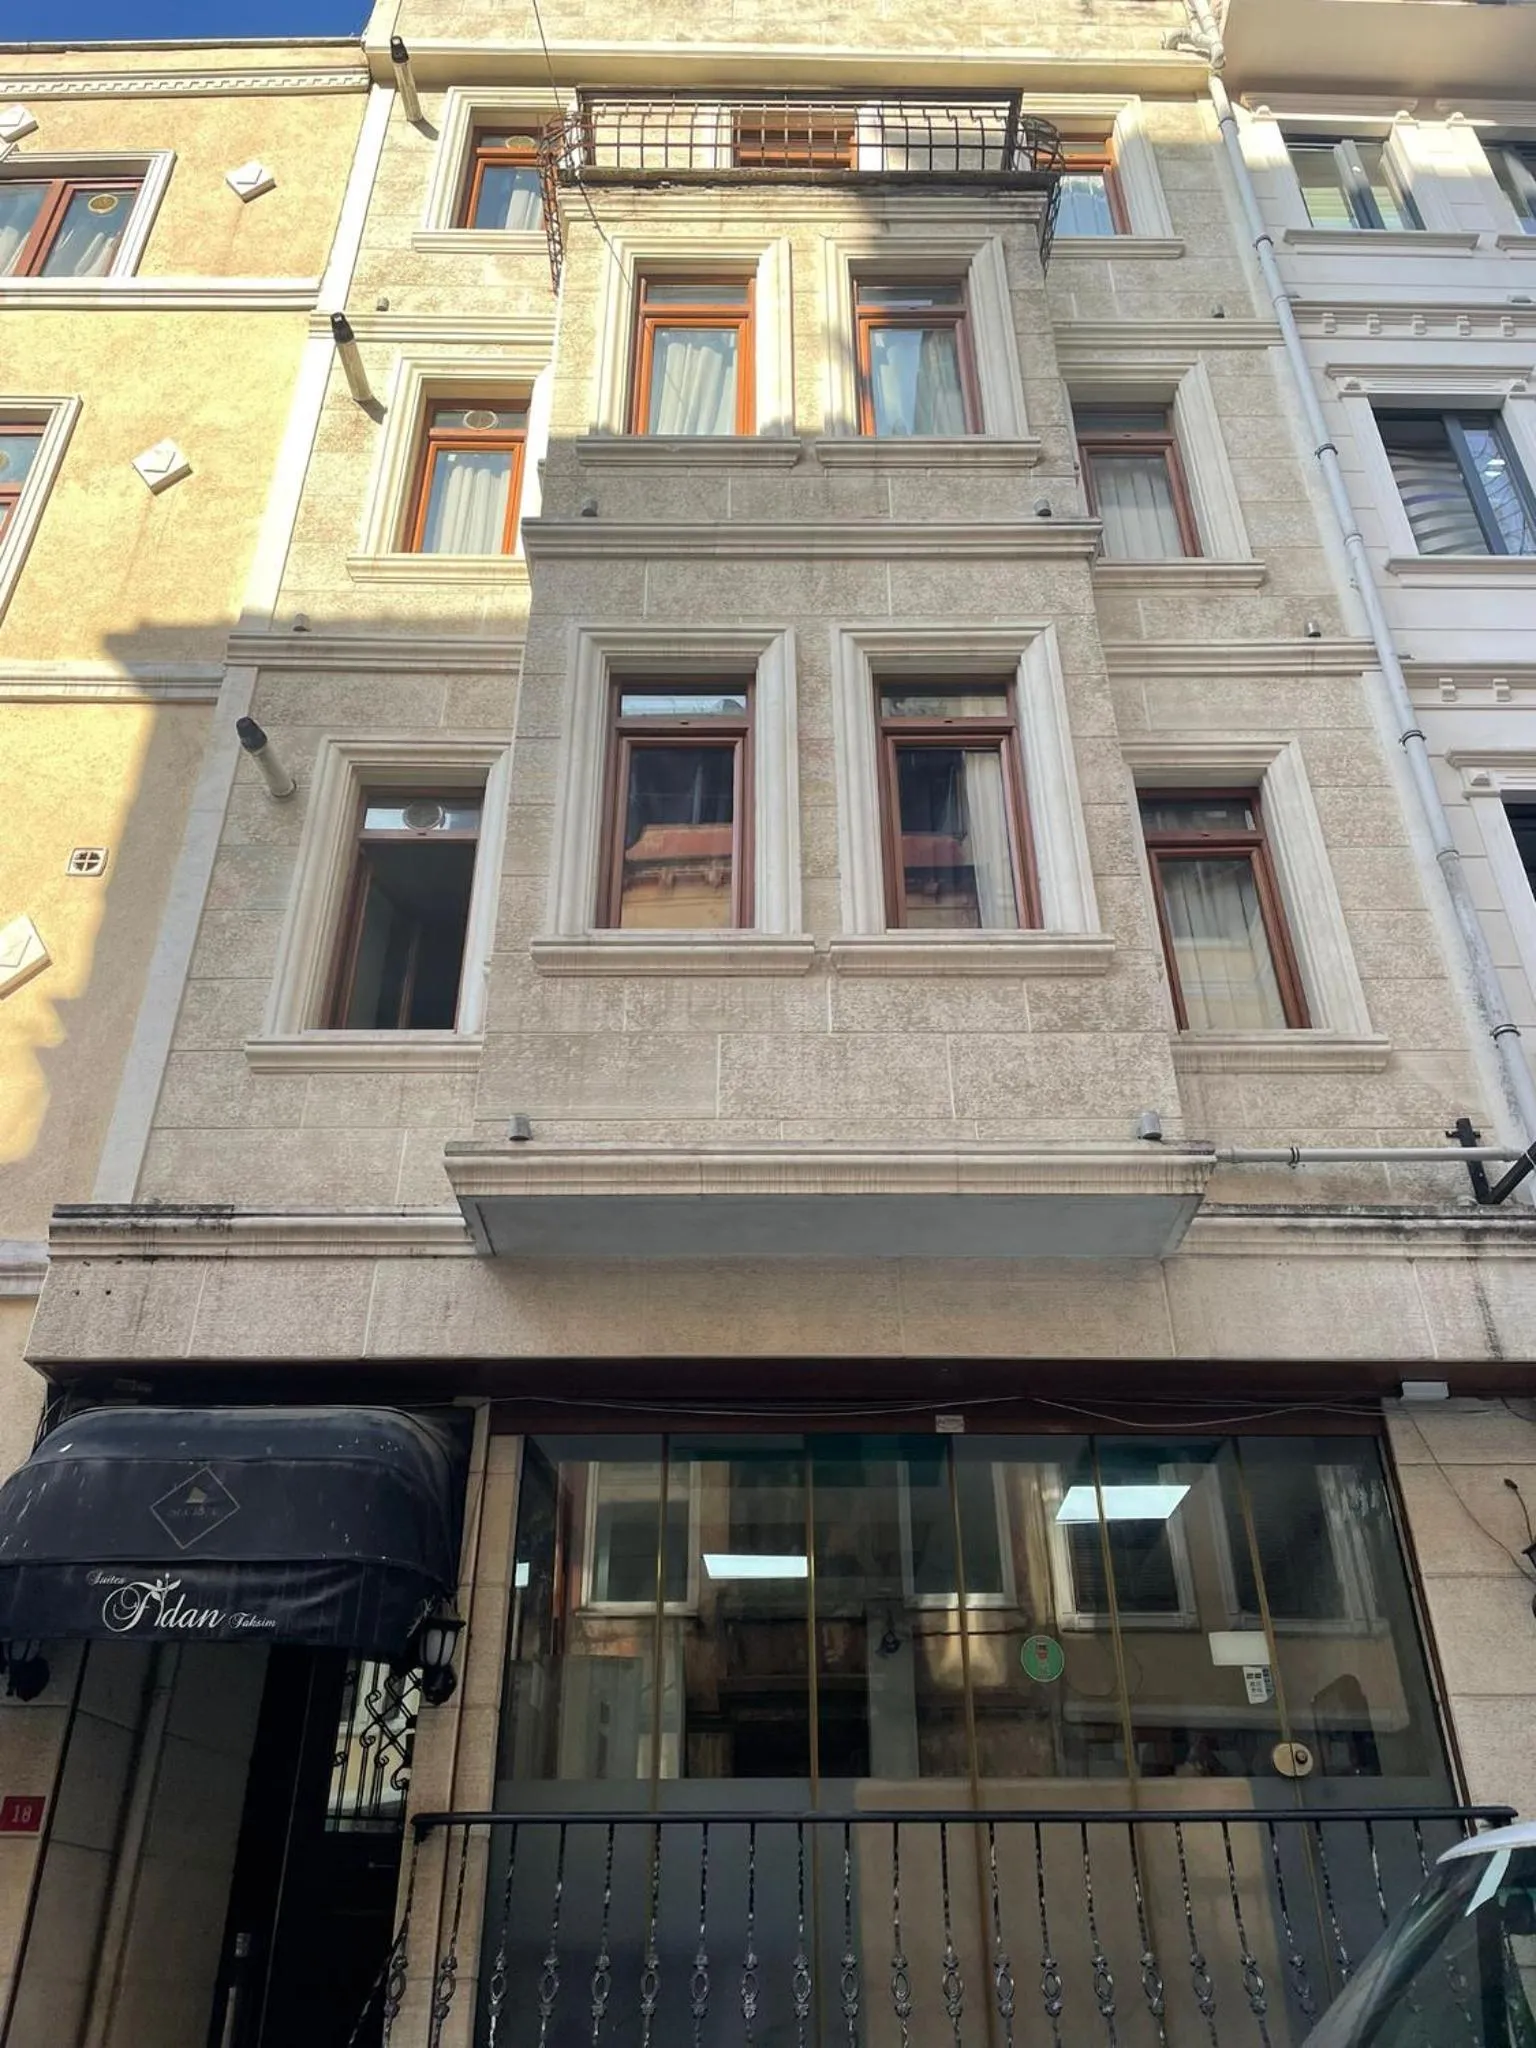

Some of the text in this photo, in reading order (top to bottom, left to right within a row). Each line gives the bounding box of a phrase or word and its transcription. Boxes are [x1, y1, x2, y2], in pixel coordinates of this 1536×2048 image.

[86, 1571, 125, 1586] Suites
[229, 1612, 276, 1628] Taksim
[11, 1804, 32, 1824] 18
